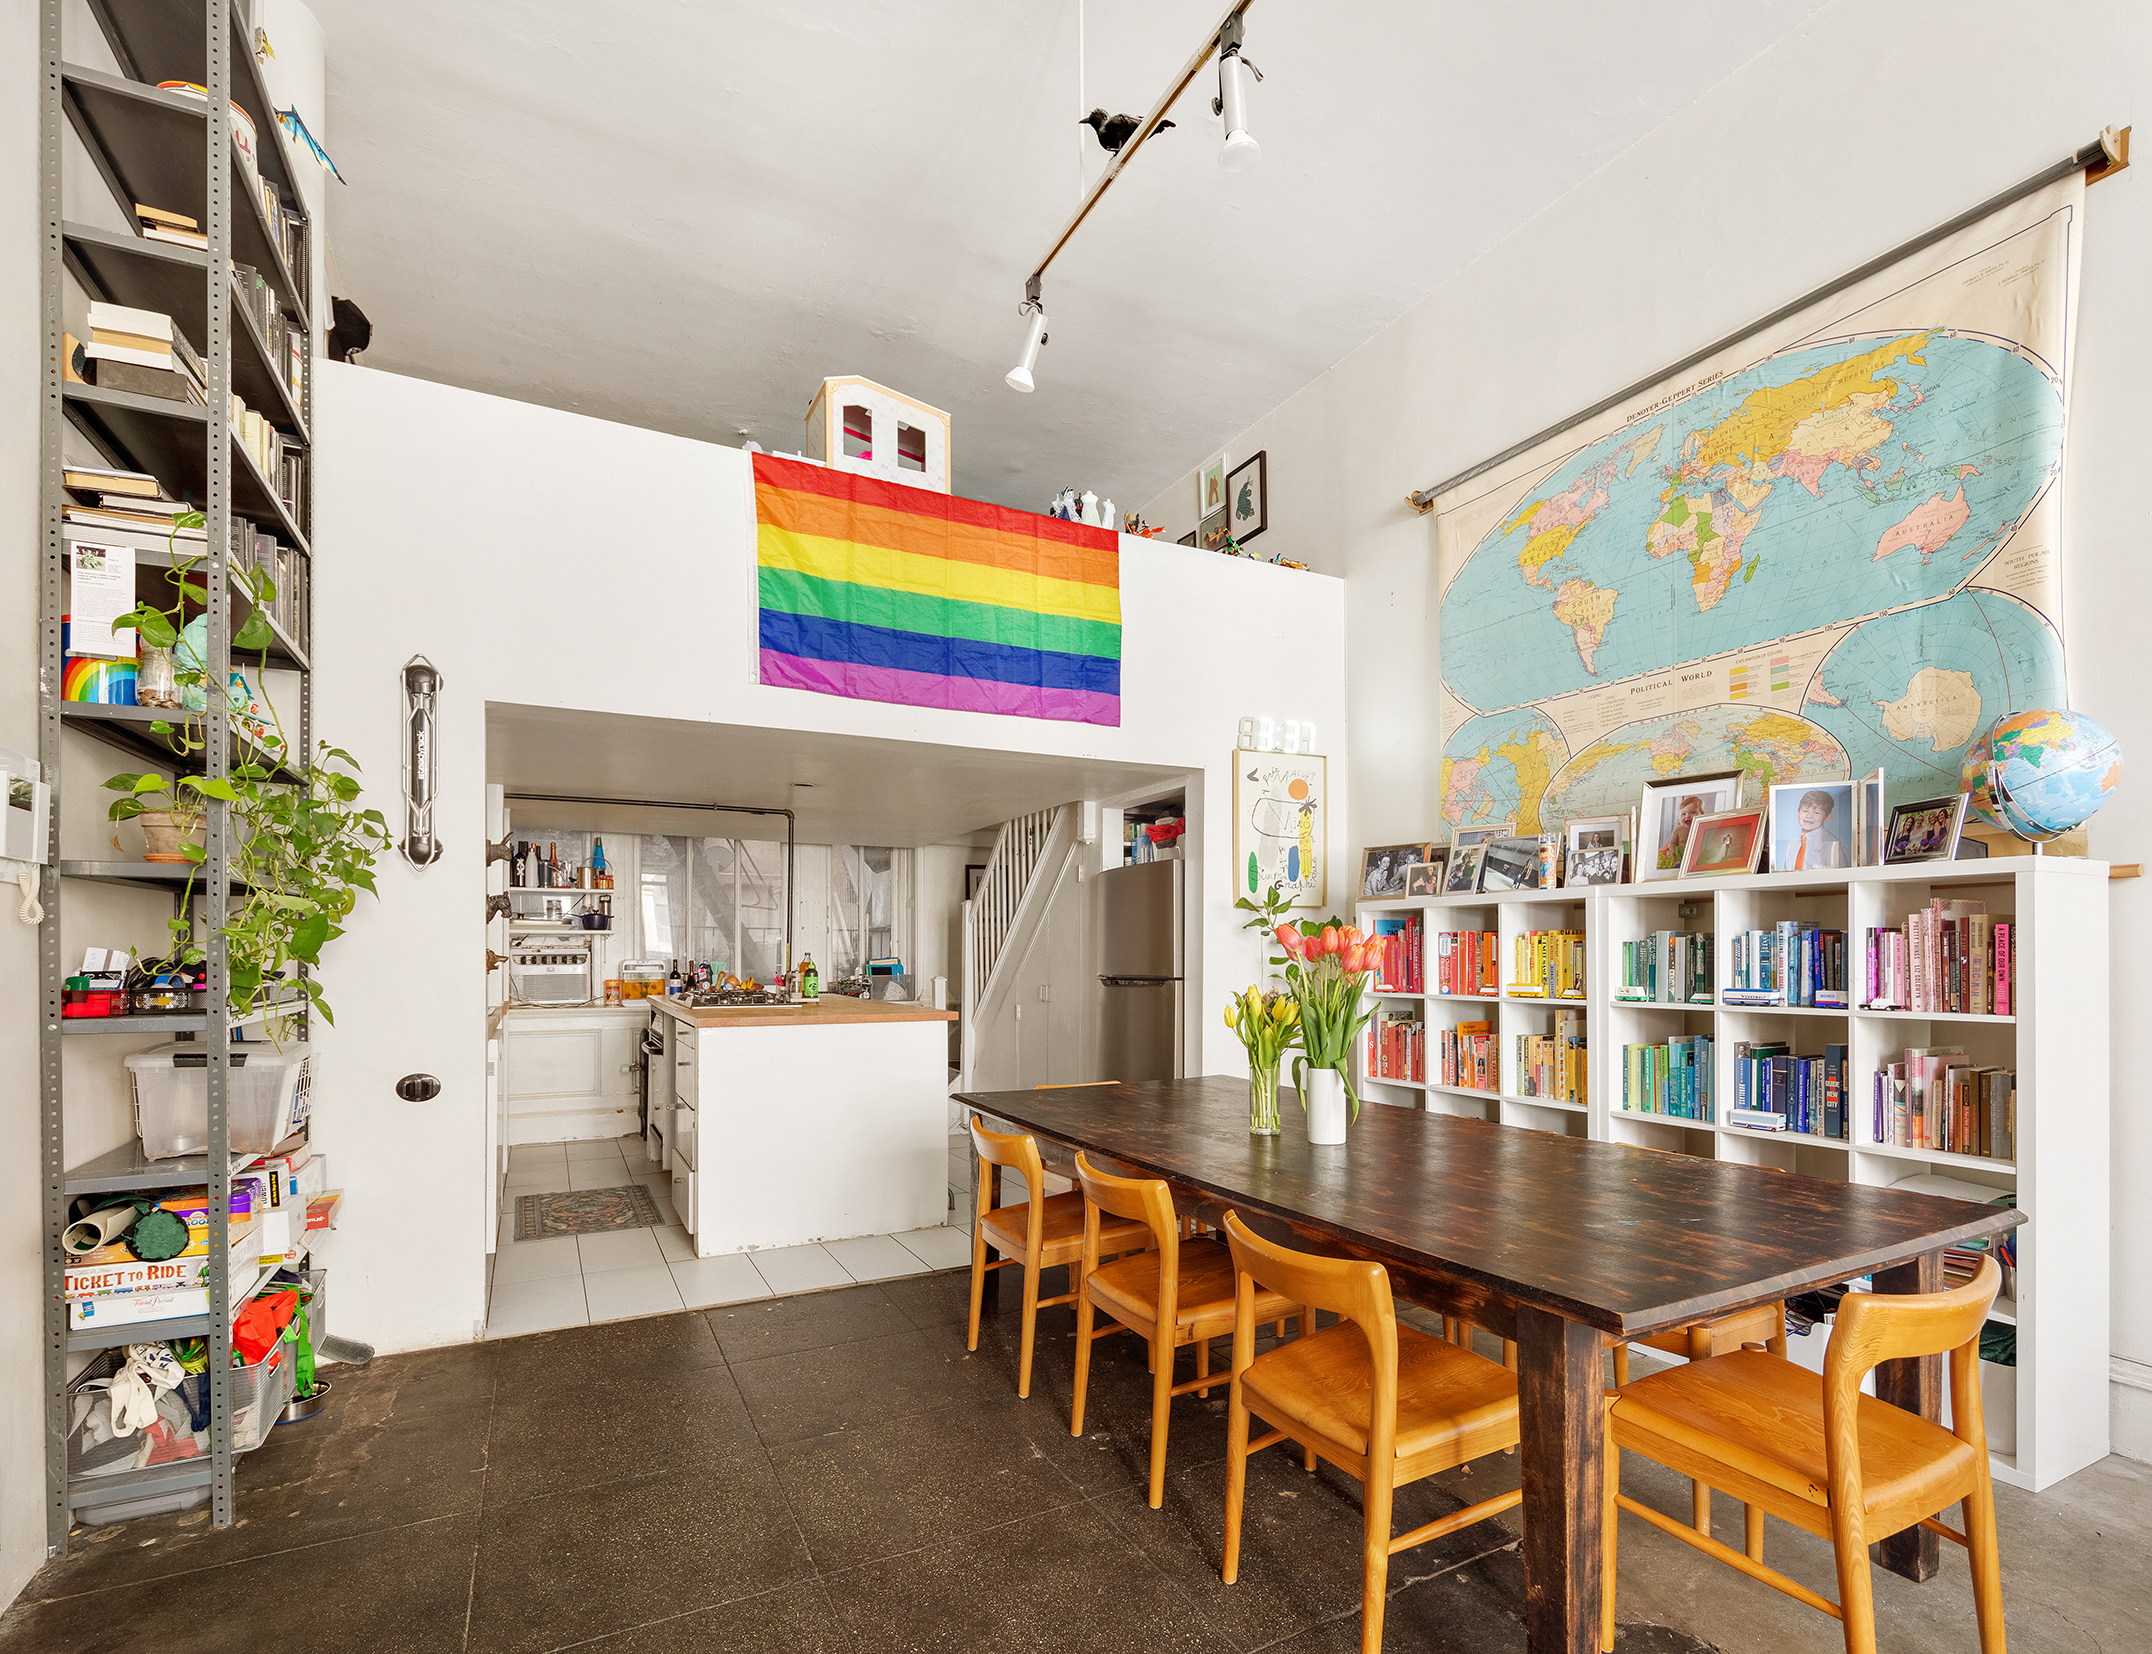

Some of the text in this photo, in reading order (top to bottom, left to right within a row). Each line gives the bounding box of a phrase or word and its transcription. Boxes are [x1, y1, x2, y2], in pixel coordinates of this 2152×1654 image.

[2011, 345, 2020, 353] 40
[1697, 370, 1724, 389] SERIES
[2050, 375, 2059, 384] 20
[1719, 424, 1741, 439] UNION
[1761, 404, 1787, 420] SOVIET
[1792, 384, 1832, 404] SOCIALIST
[1838, 360, 1886, 385] REPUBLICS
[1702, 444, 1735, 463] EUROPE
[2050, 469, 2059, 477] 20
[1895, 514, 1955, 537] AUSTRALIA
[2010, 525, 2018, 533] 40
[2004, 556, 2025, 566] SOUTH
[2013, 559, 2039, 570] REGIONS
[1572, 595, 1601, 609] SOUTH
[1573, 608, 1613, 625] AMERICA
[1878, 609, 1888, 617] 150
[1630, 679, 1673, 695] POLITICAL
[1681, 670, 1713, 683] WORLD
[1896, 695, 1958, 711] ANTARCTICA
[1971, 953, 1982, 997] AMERICANAH
[1670, 1077, 1678, 1104] WAVES
[1738, 1083, 1746, 1105] DOUGLASS
[65, 1272, 125, 1291] TICKET
[128, 1271, 143, 1281] TO
[147, 1265, 187, 1280] RIDE
